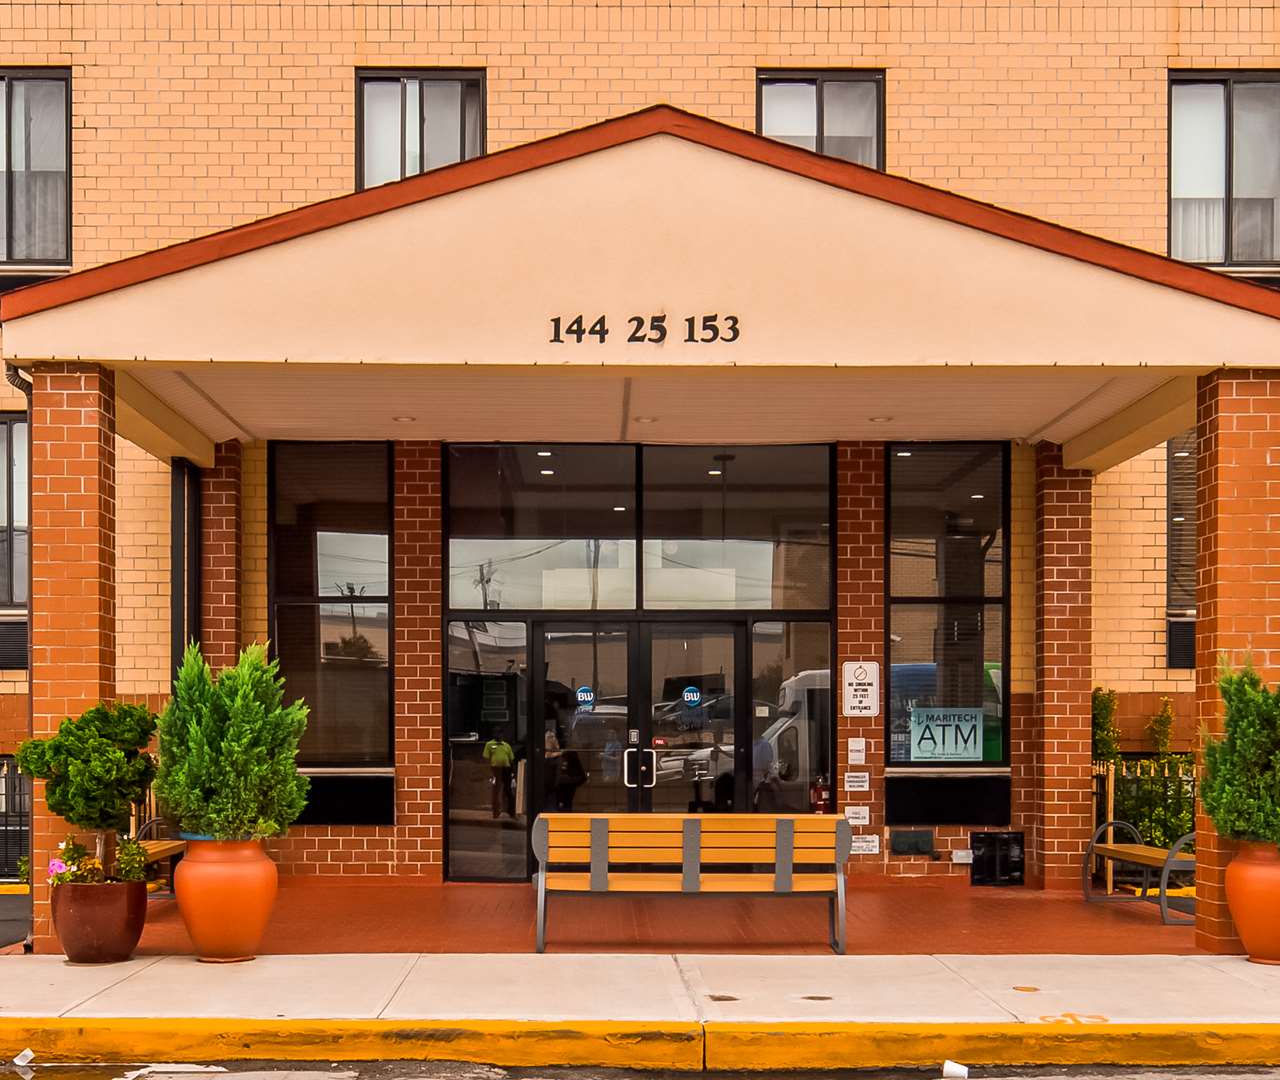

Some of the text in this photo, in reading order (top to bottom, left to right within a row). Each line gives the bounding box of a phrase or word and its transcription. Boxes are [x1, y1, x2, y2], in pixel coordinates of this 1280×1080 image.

[549, 314, 740, 344] 144 25 153
[577, 692, 594, 701] BW
[684, 692, 700, 701] BW
[925, 713, 977, 722] MARITECH
[917, 723, 977, 745] ATM
